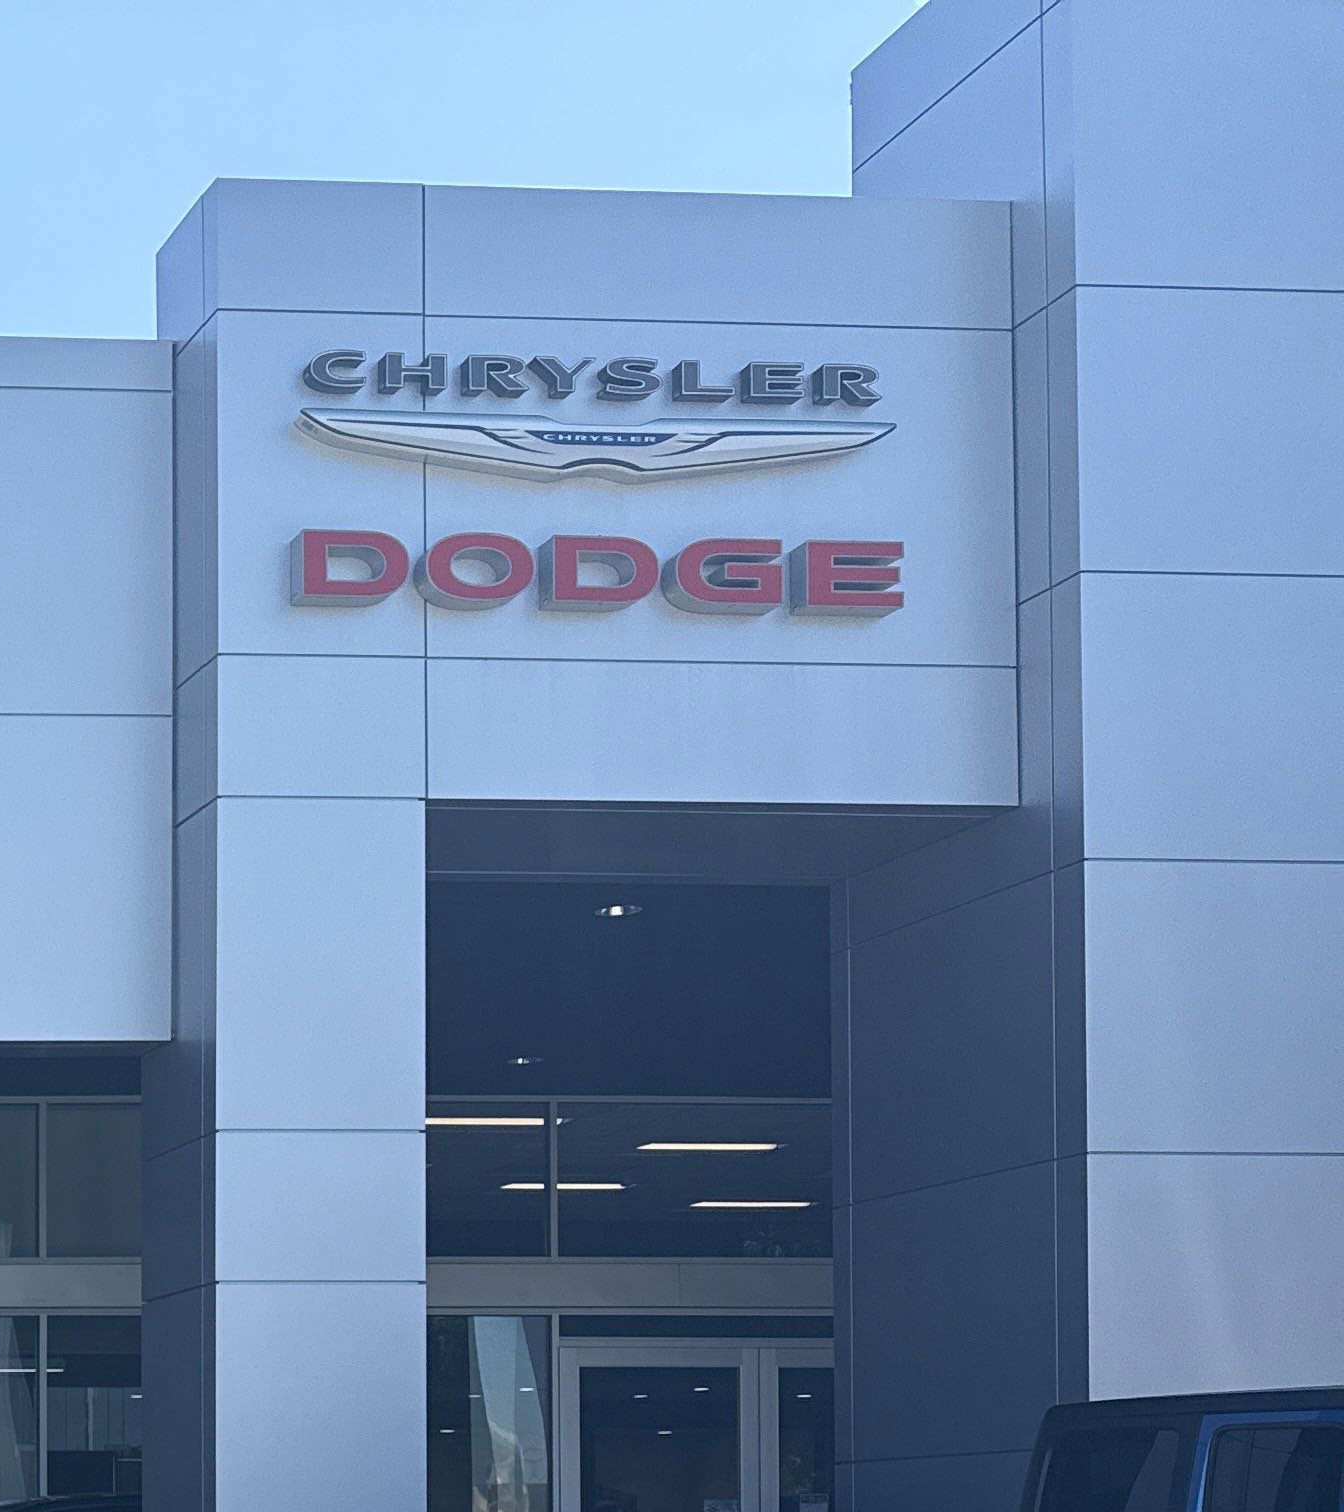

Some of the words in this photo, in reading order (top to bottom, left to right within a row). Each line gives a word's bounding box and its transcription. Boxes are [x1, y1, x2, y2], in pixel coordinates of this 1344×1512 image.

[303, 349, 883, 405] CHRYSLER
[542, 433, 657, 444] CHRYSLER
[292, 528, 905, 614] DODGE
